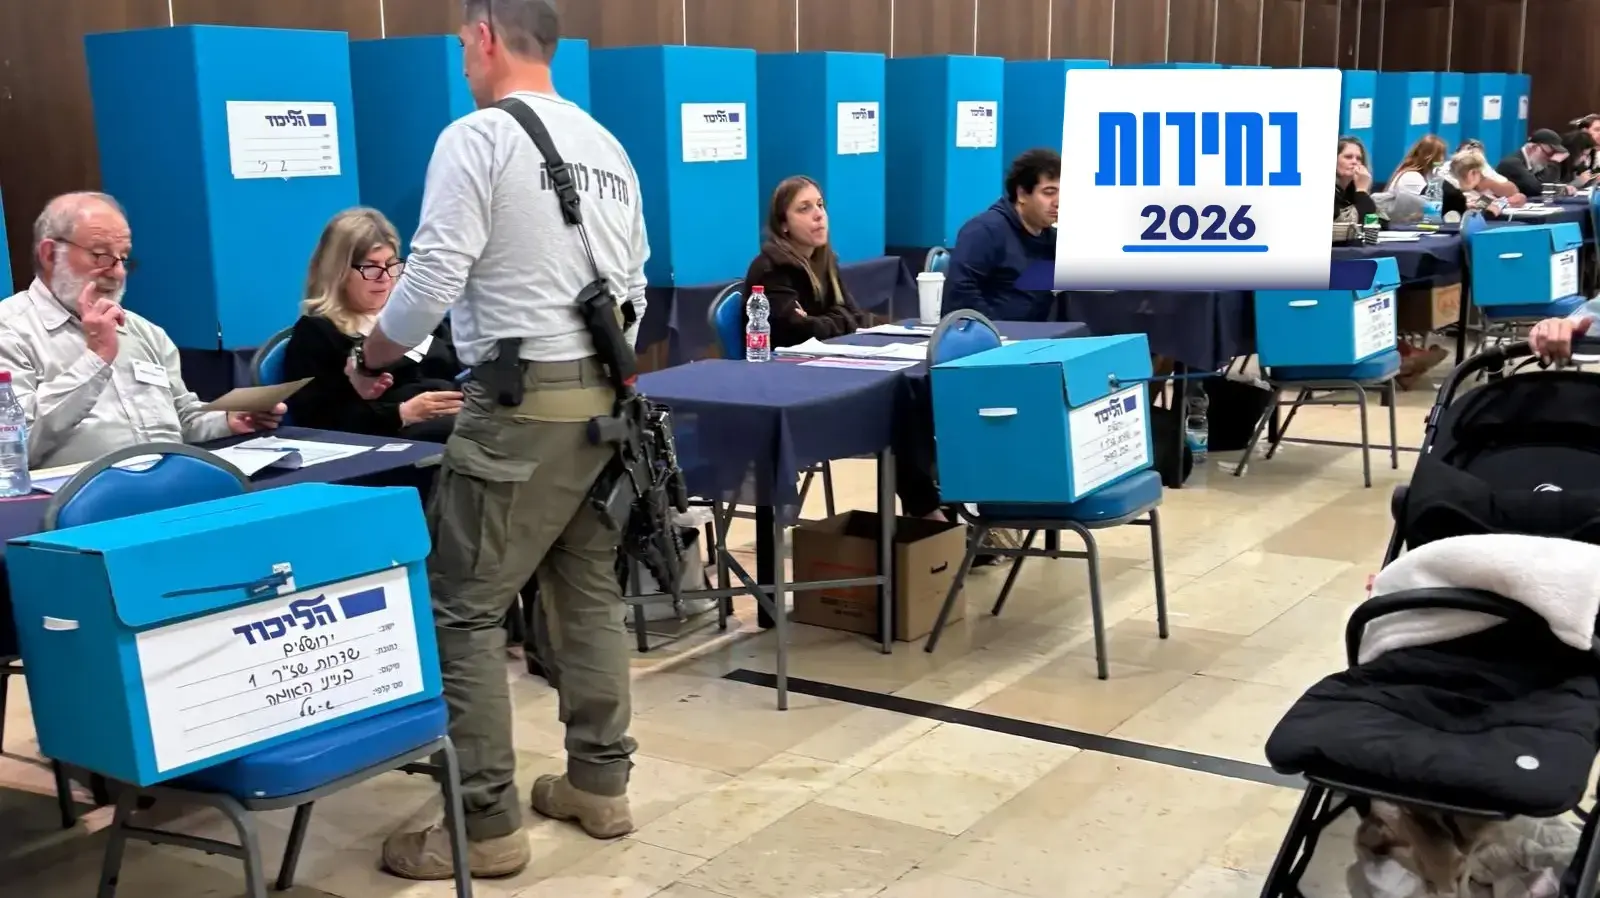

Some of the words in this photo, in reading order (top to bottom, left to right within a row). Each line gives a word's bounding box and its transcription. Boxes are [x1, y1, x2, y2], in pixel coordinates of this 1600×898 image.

[265, 109, 306, 127] הליכוד
[592, 168, 629, 206] מדריך
[1094, 398, 1123, 424] הליכוד
[233, 594, 338, 645] הליכוד
[283, 634, 335, 658] ירושלים
[314, 648, 360, 671] שדרות
[249, 674, 257, 687] 1
[266, 682, 313, 706] האומה
